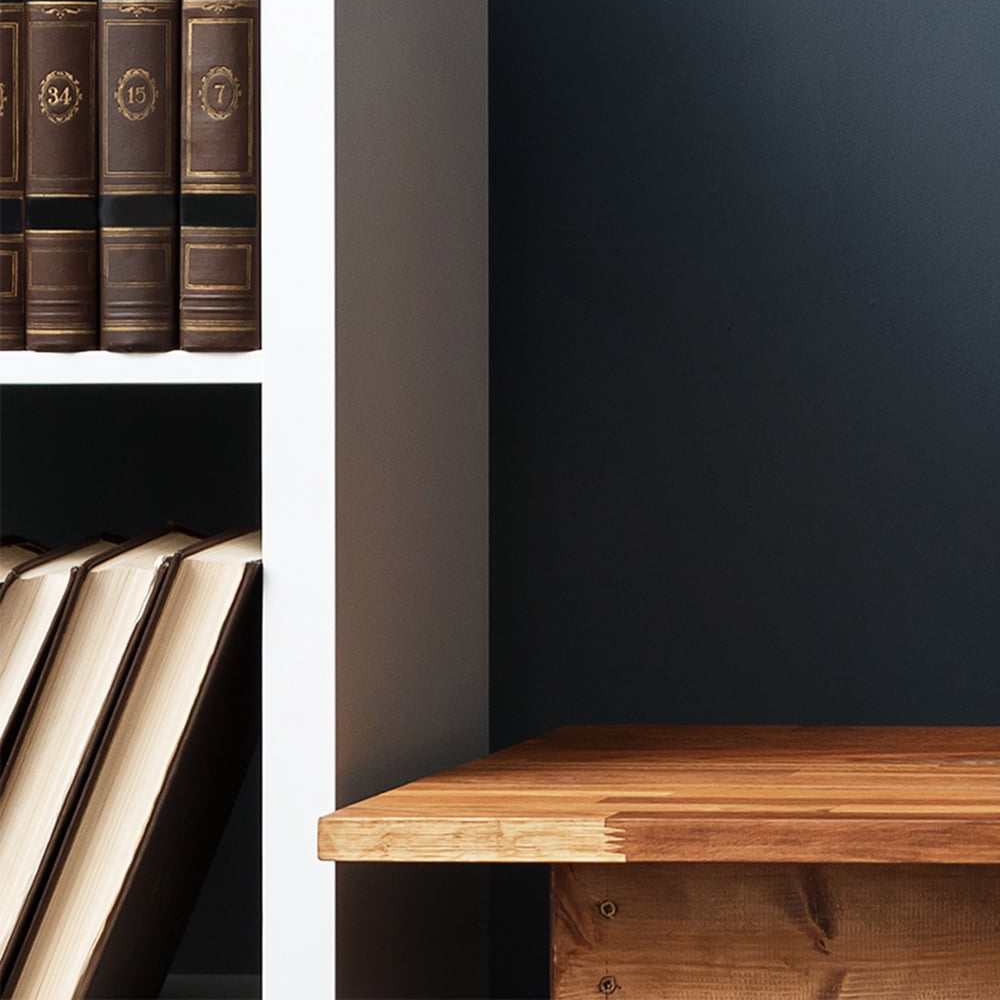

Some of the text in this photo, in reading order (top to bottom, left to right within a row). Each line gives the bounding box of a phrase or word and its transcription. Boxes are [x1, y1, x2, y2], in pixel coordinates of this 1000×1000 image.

[48, 86, 72, 105] 34
[127, 86, 146, 104] 15
[214, 85, 225, 103] 7
